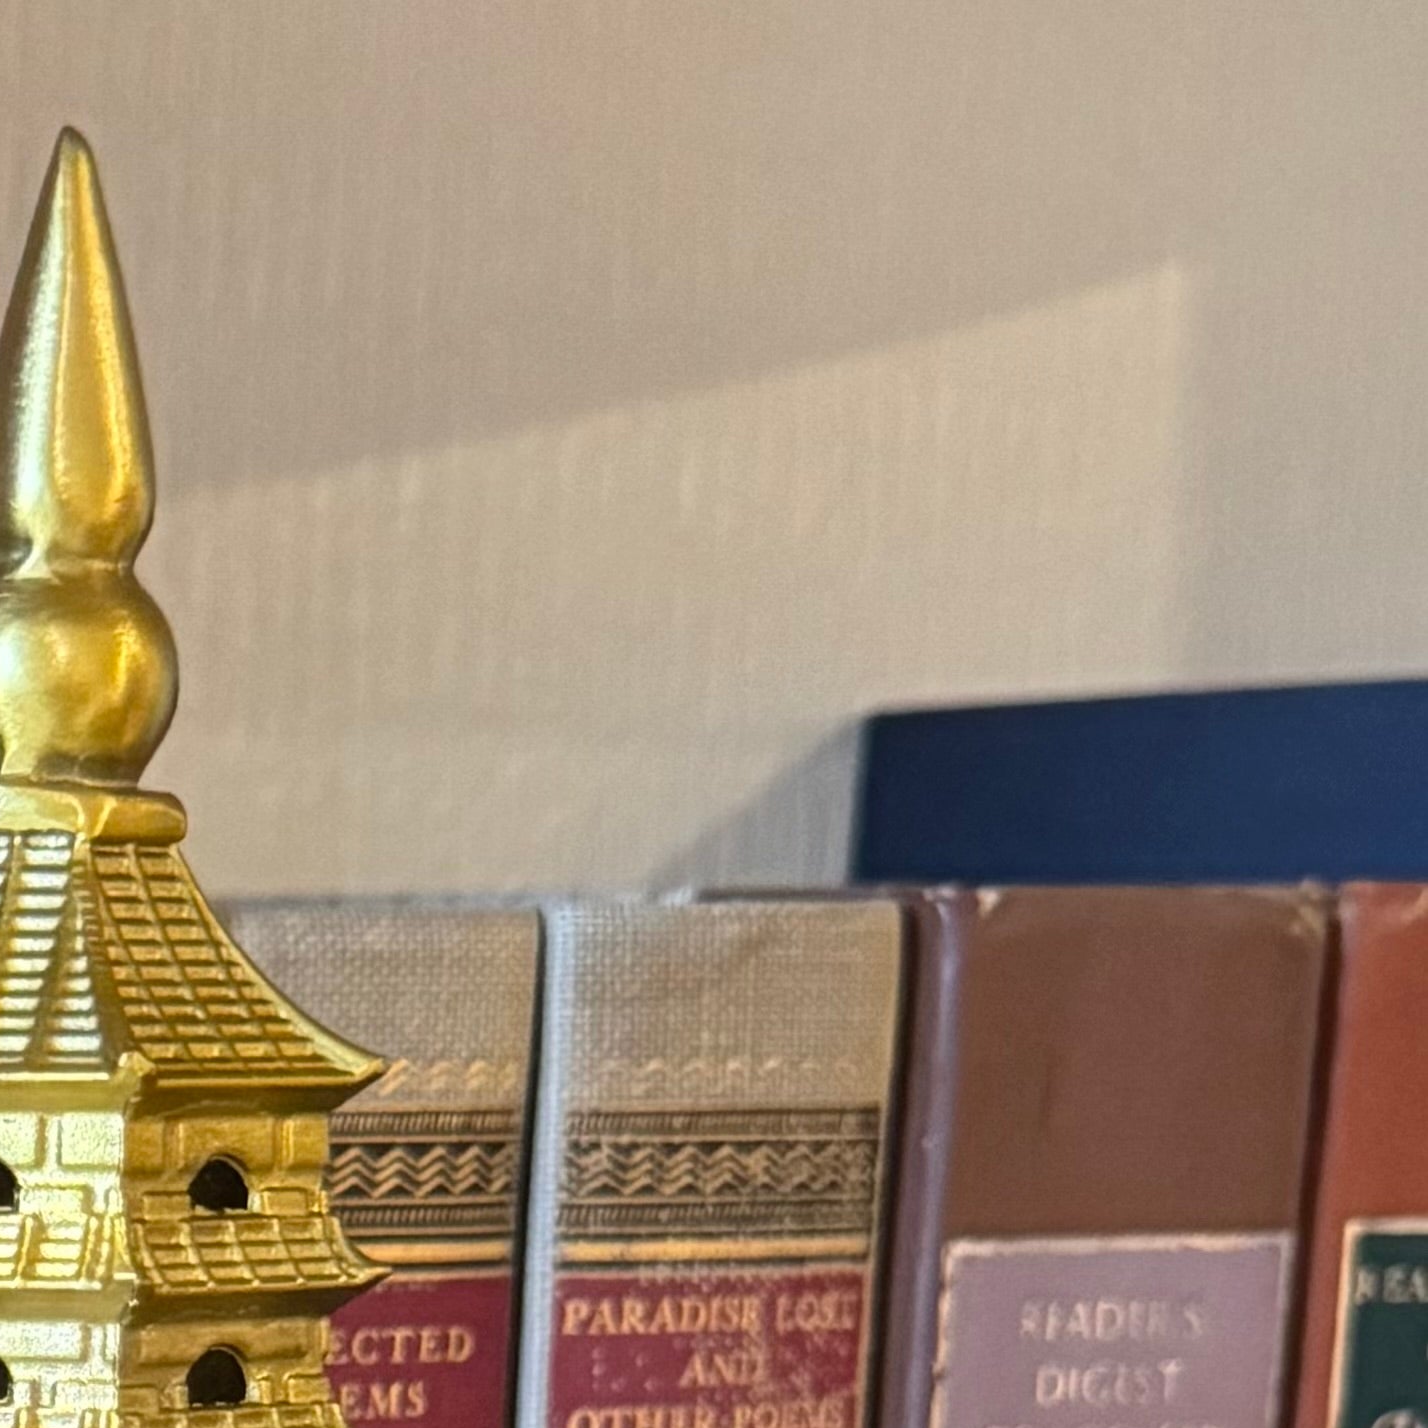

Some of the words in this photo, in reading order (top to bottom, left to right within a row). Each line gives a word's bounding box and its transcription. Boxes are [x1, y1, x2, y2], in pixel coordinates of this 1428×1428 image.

[561, 1295, 762, 1337] PARADISE
[325, 1326, 476, 1368] ECTED
[679, 1352, 767, 1388] AND
[341, 1380, 429, 1421] EMS
